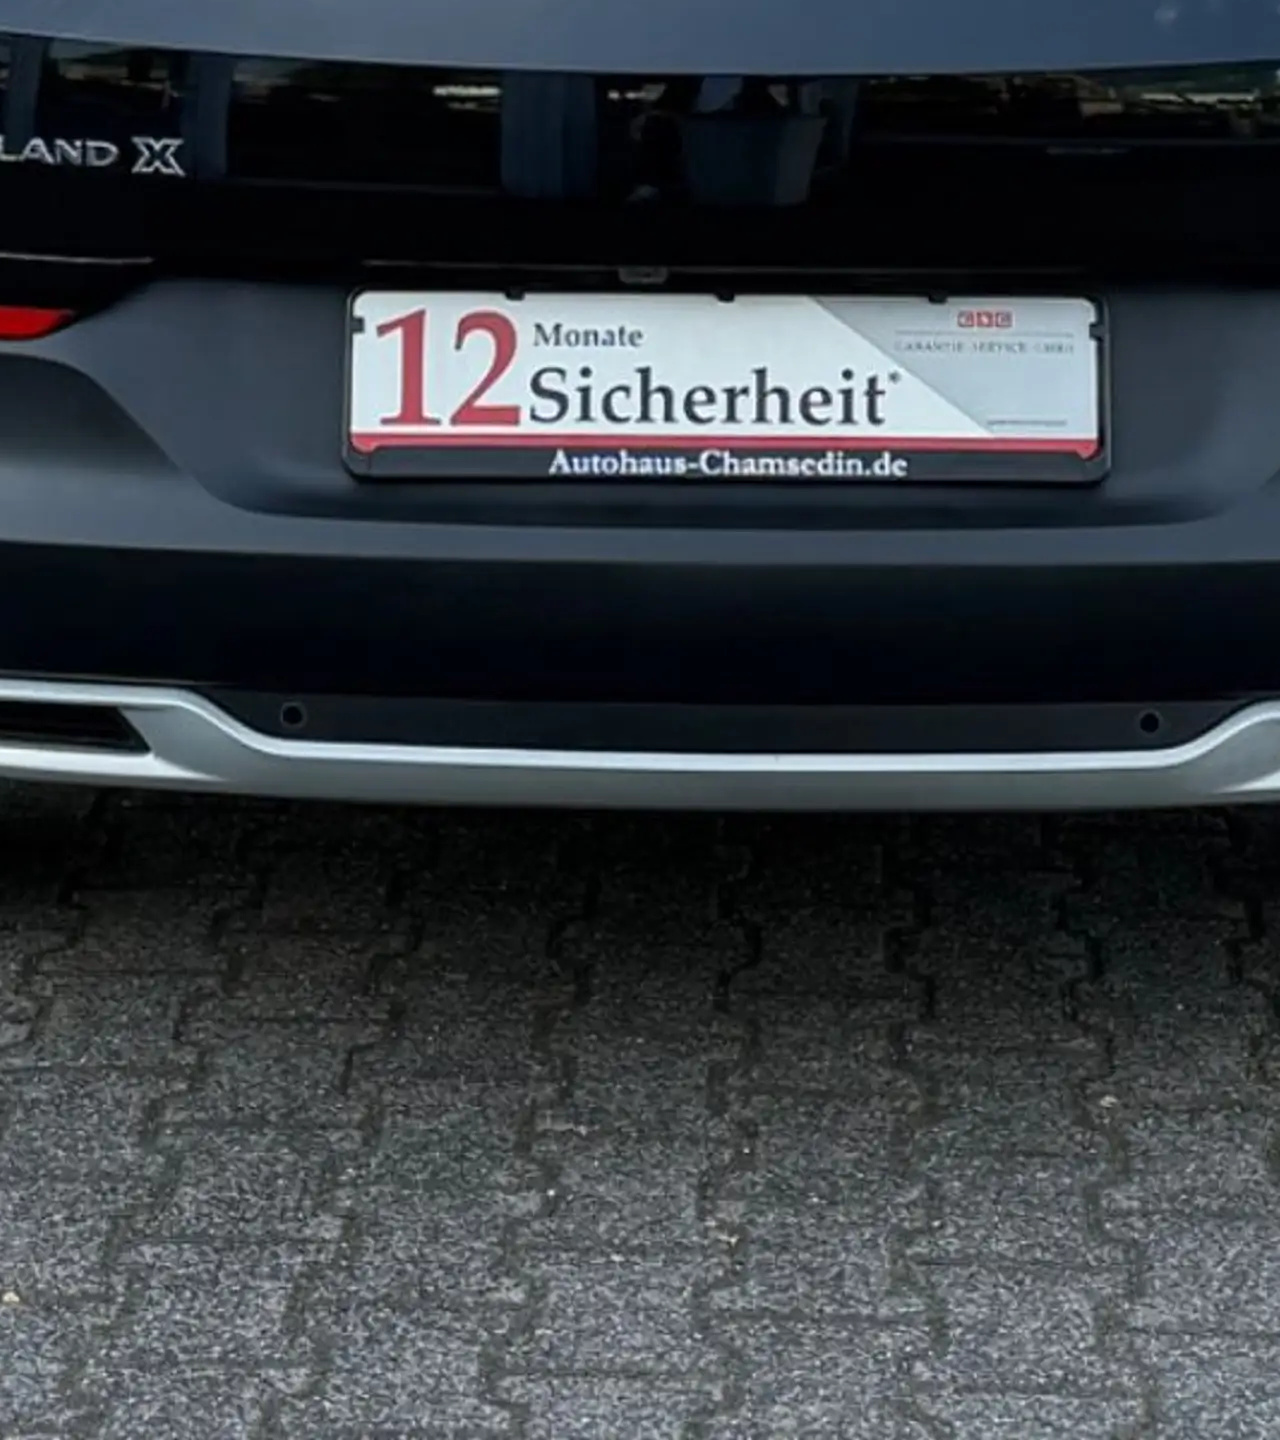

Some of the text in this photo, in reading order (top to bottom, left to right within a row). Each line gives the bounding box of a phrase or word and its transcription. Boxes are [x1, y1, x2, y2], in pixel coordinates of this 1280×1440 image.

[131, 136, 186, 177] X
[532, 323, 643, 348] Monate
[376, 308, 522, 427] 12
[549, 448, 908, 477] Autohaus-Chamsedin.de
